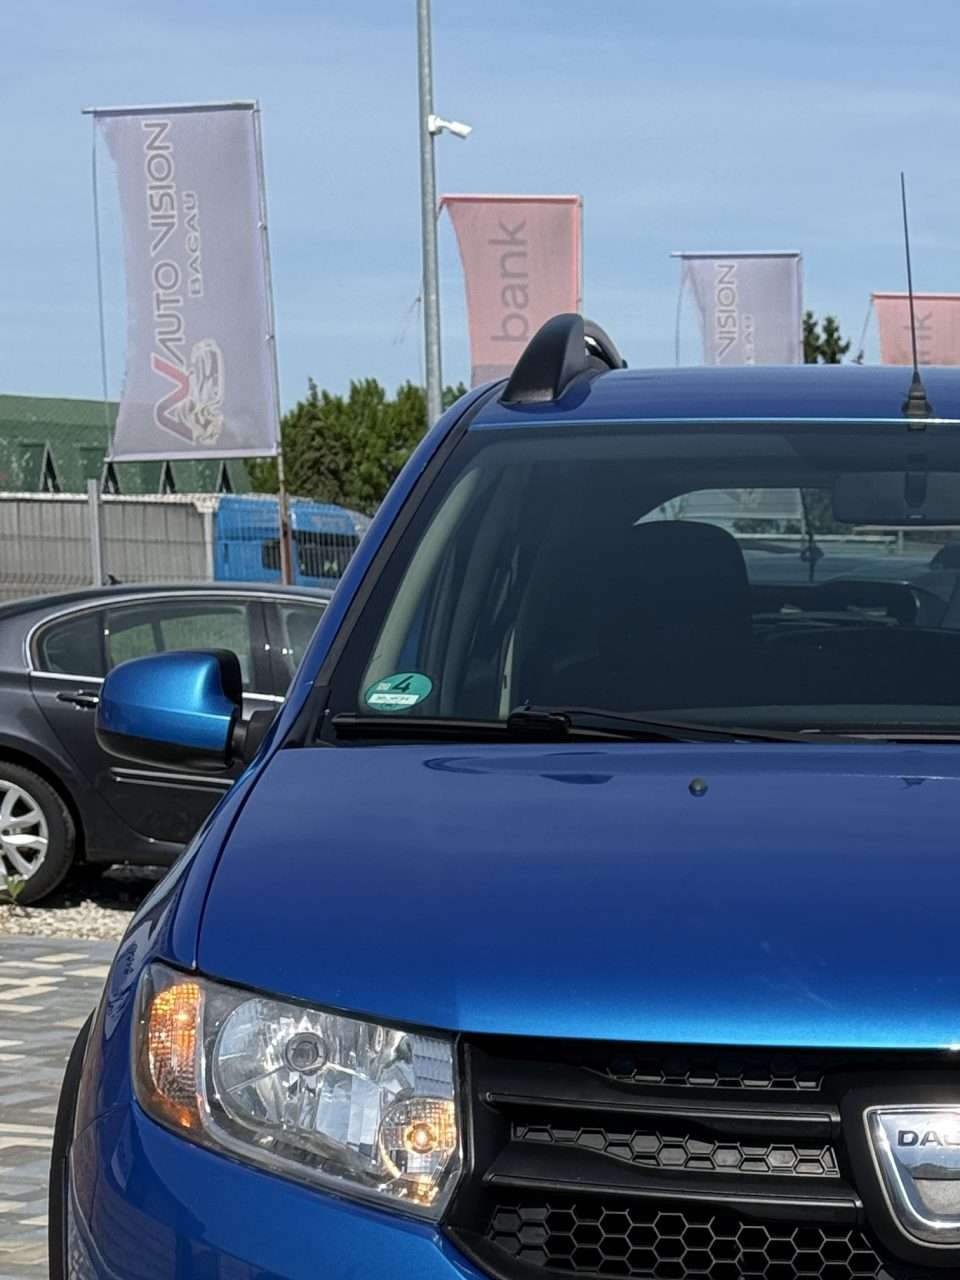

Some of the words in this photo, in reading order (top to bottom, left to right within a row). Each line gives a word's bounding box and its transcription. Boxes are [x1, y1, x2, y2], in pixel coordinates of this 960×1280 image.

[143, 121, 177, 253] VISION
[154, 261, 185, 367] AUTO
[488, 219, 529, 342] bank
[716, 264, 737, 358] VISION
